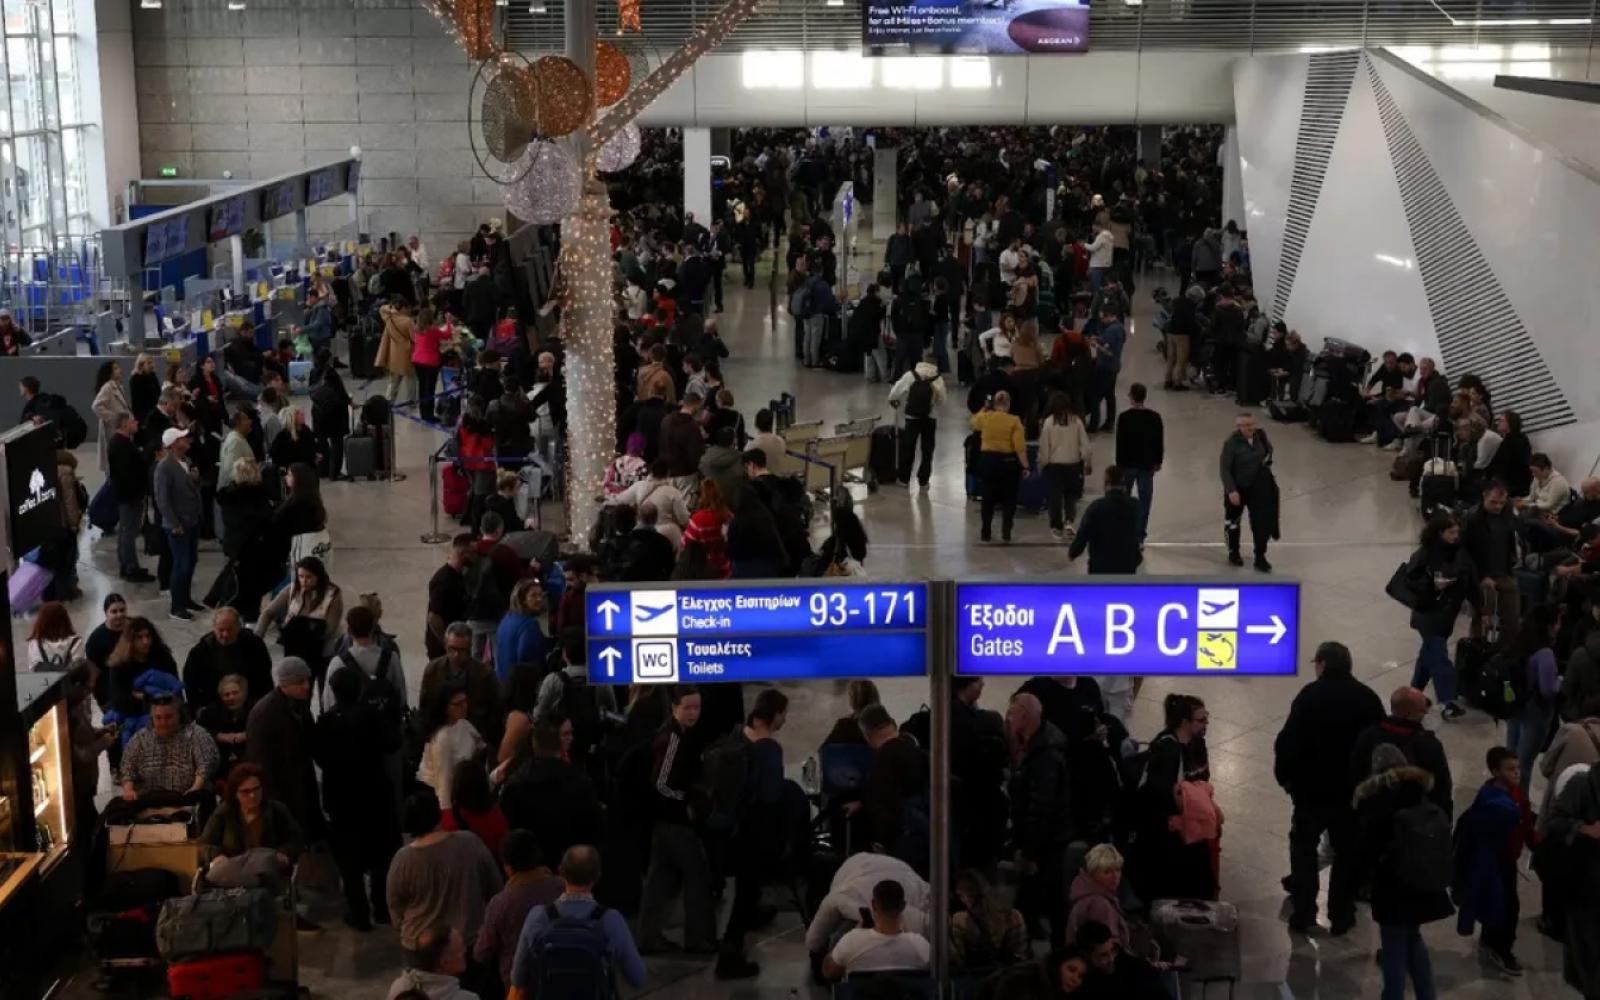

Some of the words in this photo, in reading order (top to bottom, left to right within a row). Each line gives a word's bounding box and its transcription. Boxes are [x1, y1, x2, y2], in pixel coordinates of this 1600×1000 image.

[868, 6, 889, 15] Free
[868, 17, 882, 25] for
[883, 16, 895, 25] all
[897, 16, 955, 25] Miles+Bonus
[678, 595, 732, 611] Έλεγχος
[735, 594, 801, 609] Εισιτηρίων
[808, 589, 916, 627] 93-171
[682, 616, 731, 630] Check-in
[963, 603, 1035, 630] Έξοδοι
[1046, 603, 1085, 655] A
[1105, 603, 1136, 655] B
[1156, 603, 1190, 657] C
[686, 641, 752, 657] Τουαλέτες
[971, 633, 1023, 657] Gates
[642, 652, 668, 668] WC
[687, 660, 724, 675] Toilets
